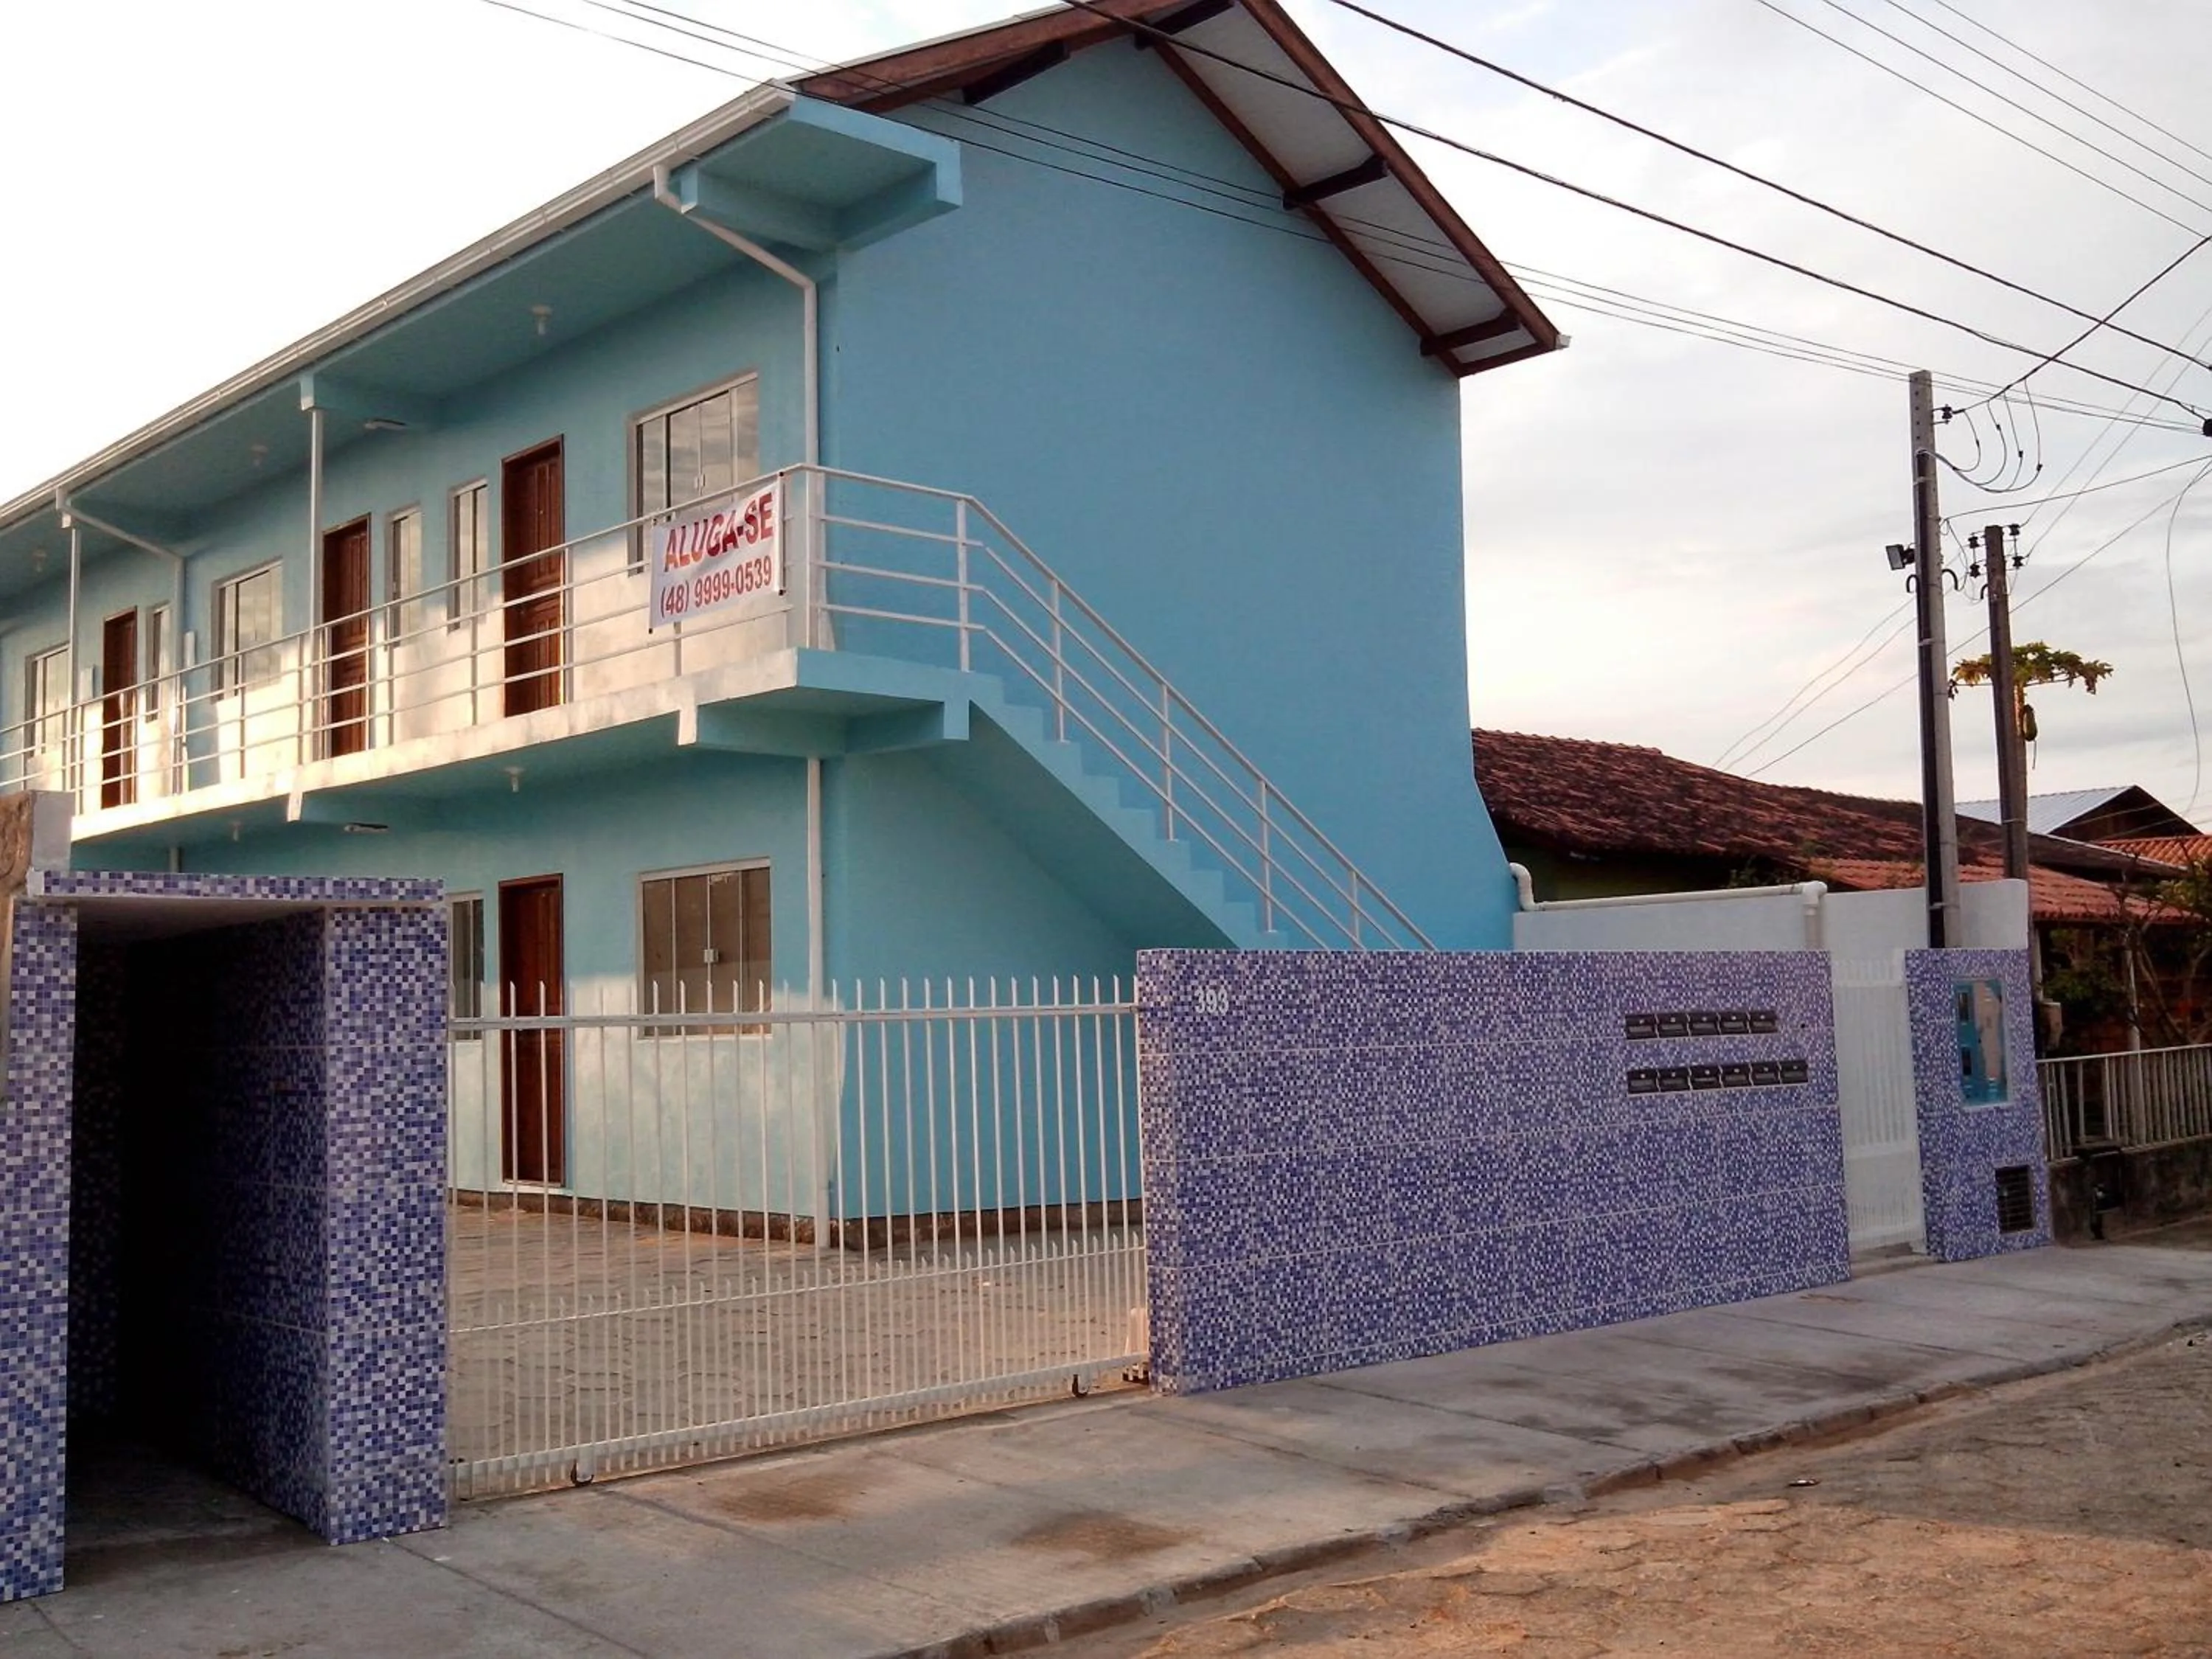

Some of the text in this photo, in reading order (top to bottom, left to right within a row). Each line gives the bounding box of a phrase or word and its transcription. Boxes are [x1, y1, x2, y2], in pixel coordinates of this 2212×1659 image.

[664, 493, 773, 572] ALUGA-SE
[661, 555, 772, 618] (48) 9999-0539
